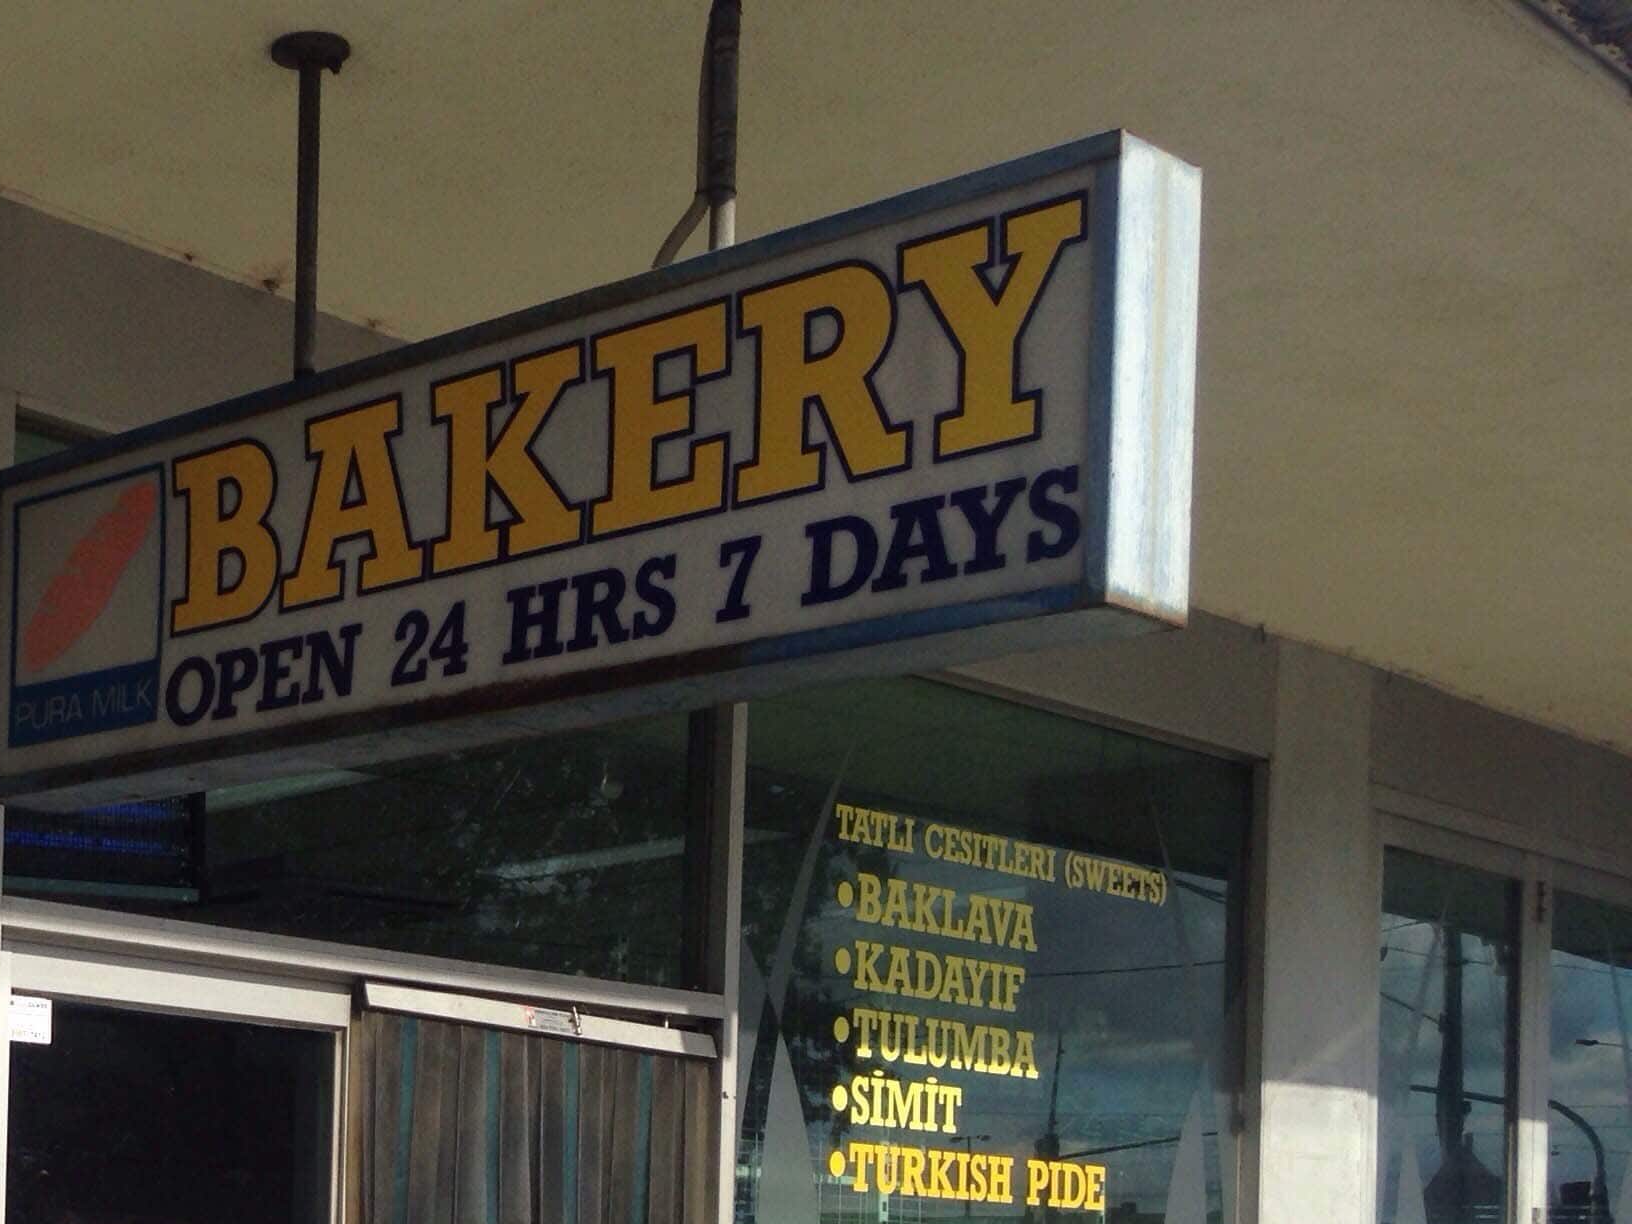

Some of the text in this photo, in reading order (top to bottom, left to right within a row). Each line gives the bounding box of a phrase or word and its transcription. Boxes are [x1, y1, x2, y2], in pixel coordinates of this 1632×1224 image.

[170, 188, 1089, 638] BAKERY
[165, 465, 1081, 727] OPEN 24 HRS 7 DAYS
[15, 679, 153, 730] PURA MILK
[836, 803, 1168, 907] TATLI CESITLERI (SWEETS)
[856, 873, 1038, 952] BAKLAVA
[853, 940, 1026, 1012] KADAYIF
[853, 1008, 1039, 1079] TULUMBA
[849, 1143, 1106, 1211] TURKISH PIDE
